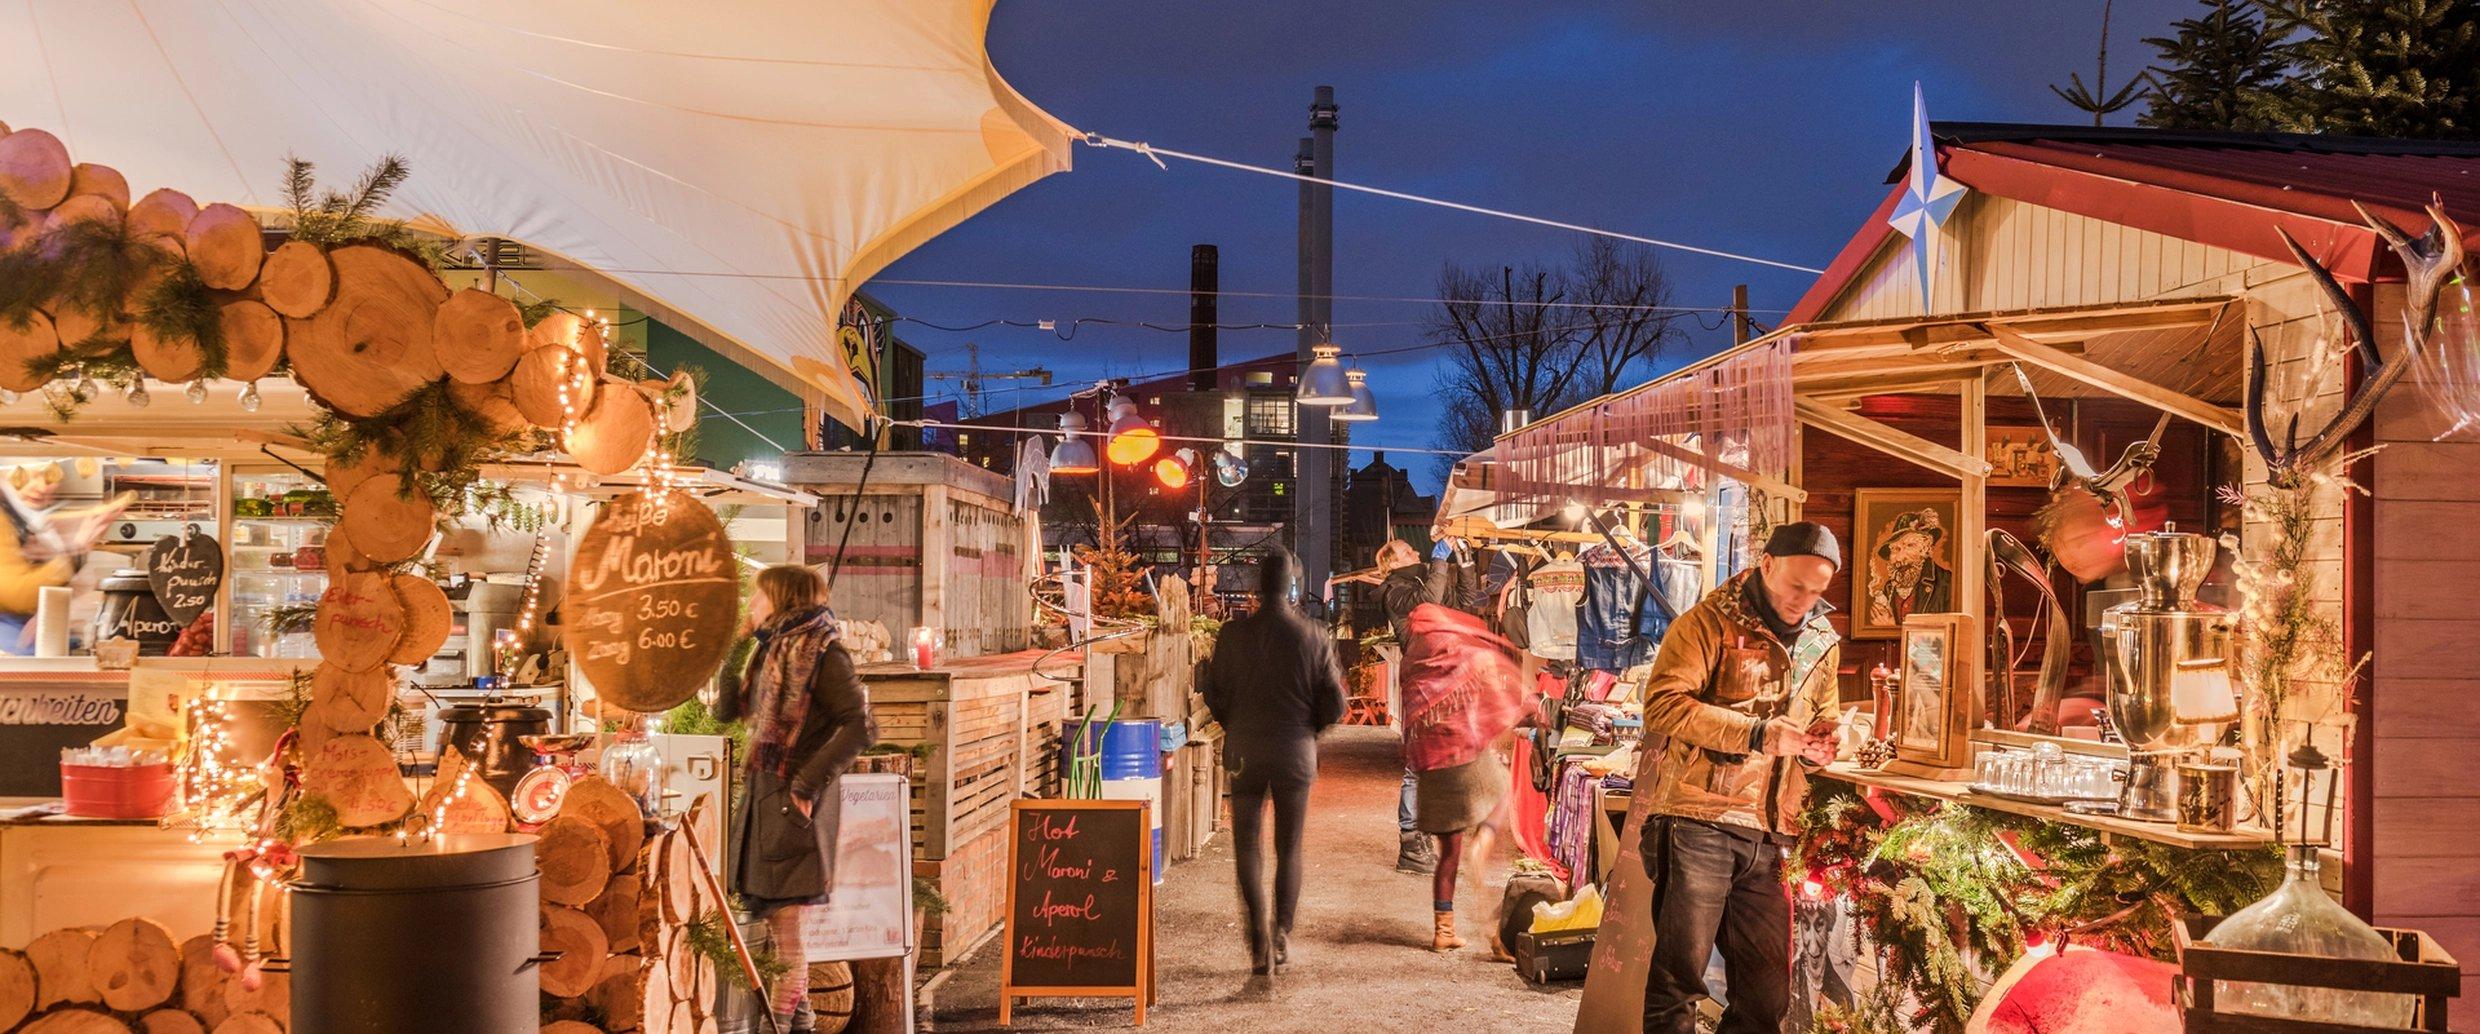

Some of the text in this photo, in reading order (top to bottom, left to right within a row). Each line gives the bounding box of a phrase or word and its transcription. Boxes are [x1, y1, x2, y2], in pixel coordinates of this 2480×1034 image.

[579, 531, 723, 590] Maroni
[173, 594, 206, 608] 2.50
[636, 594, 699, 620] 3.50 €
[637, 627, 697, 650] 6.00 €
[1027, 812, 1080, 841] Hot
[1023, 844, 1119, 882] Maroni &
[1032, 890, 1102, 927] Aperol
[1020, 935, 1128, 971] Kinderpunsch
